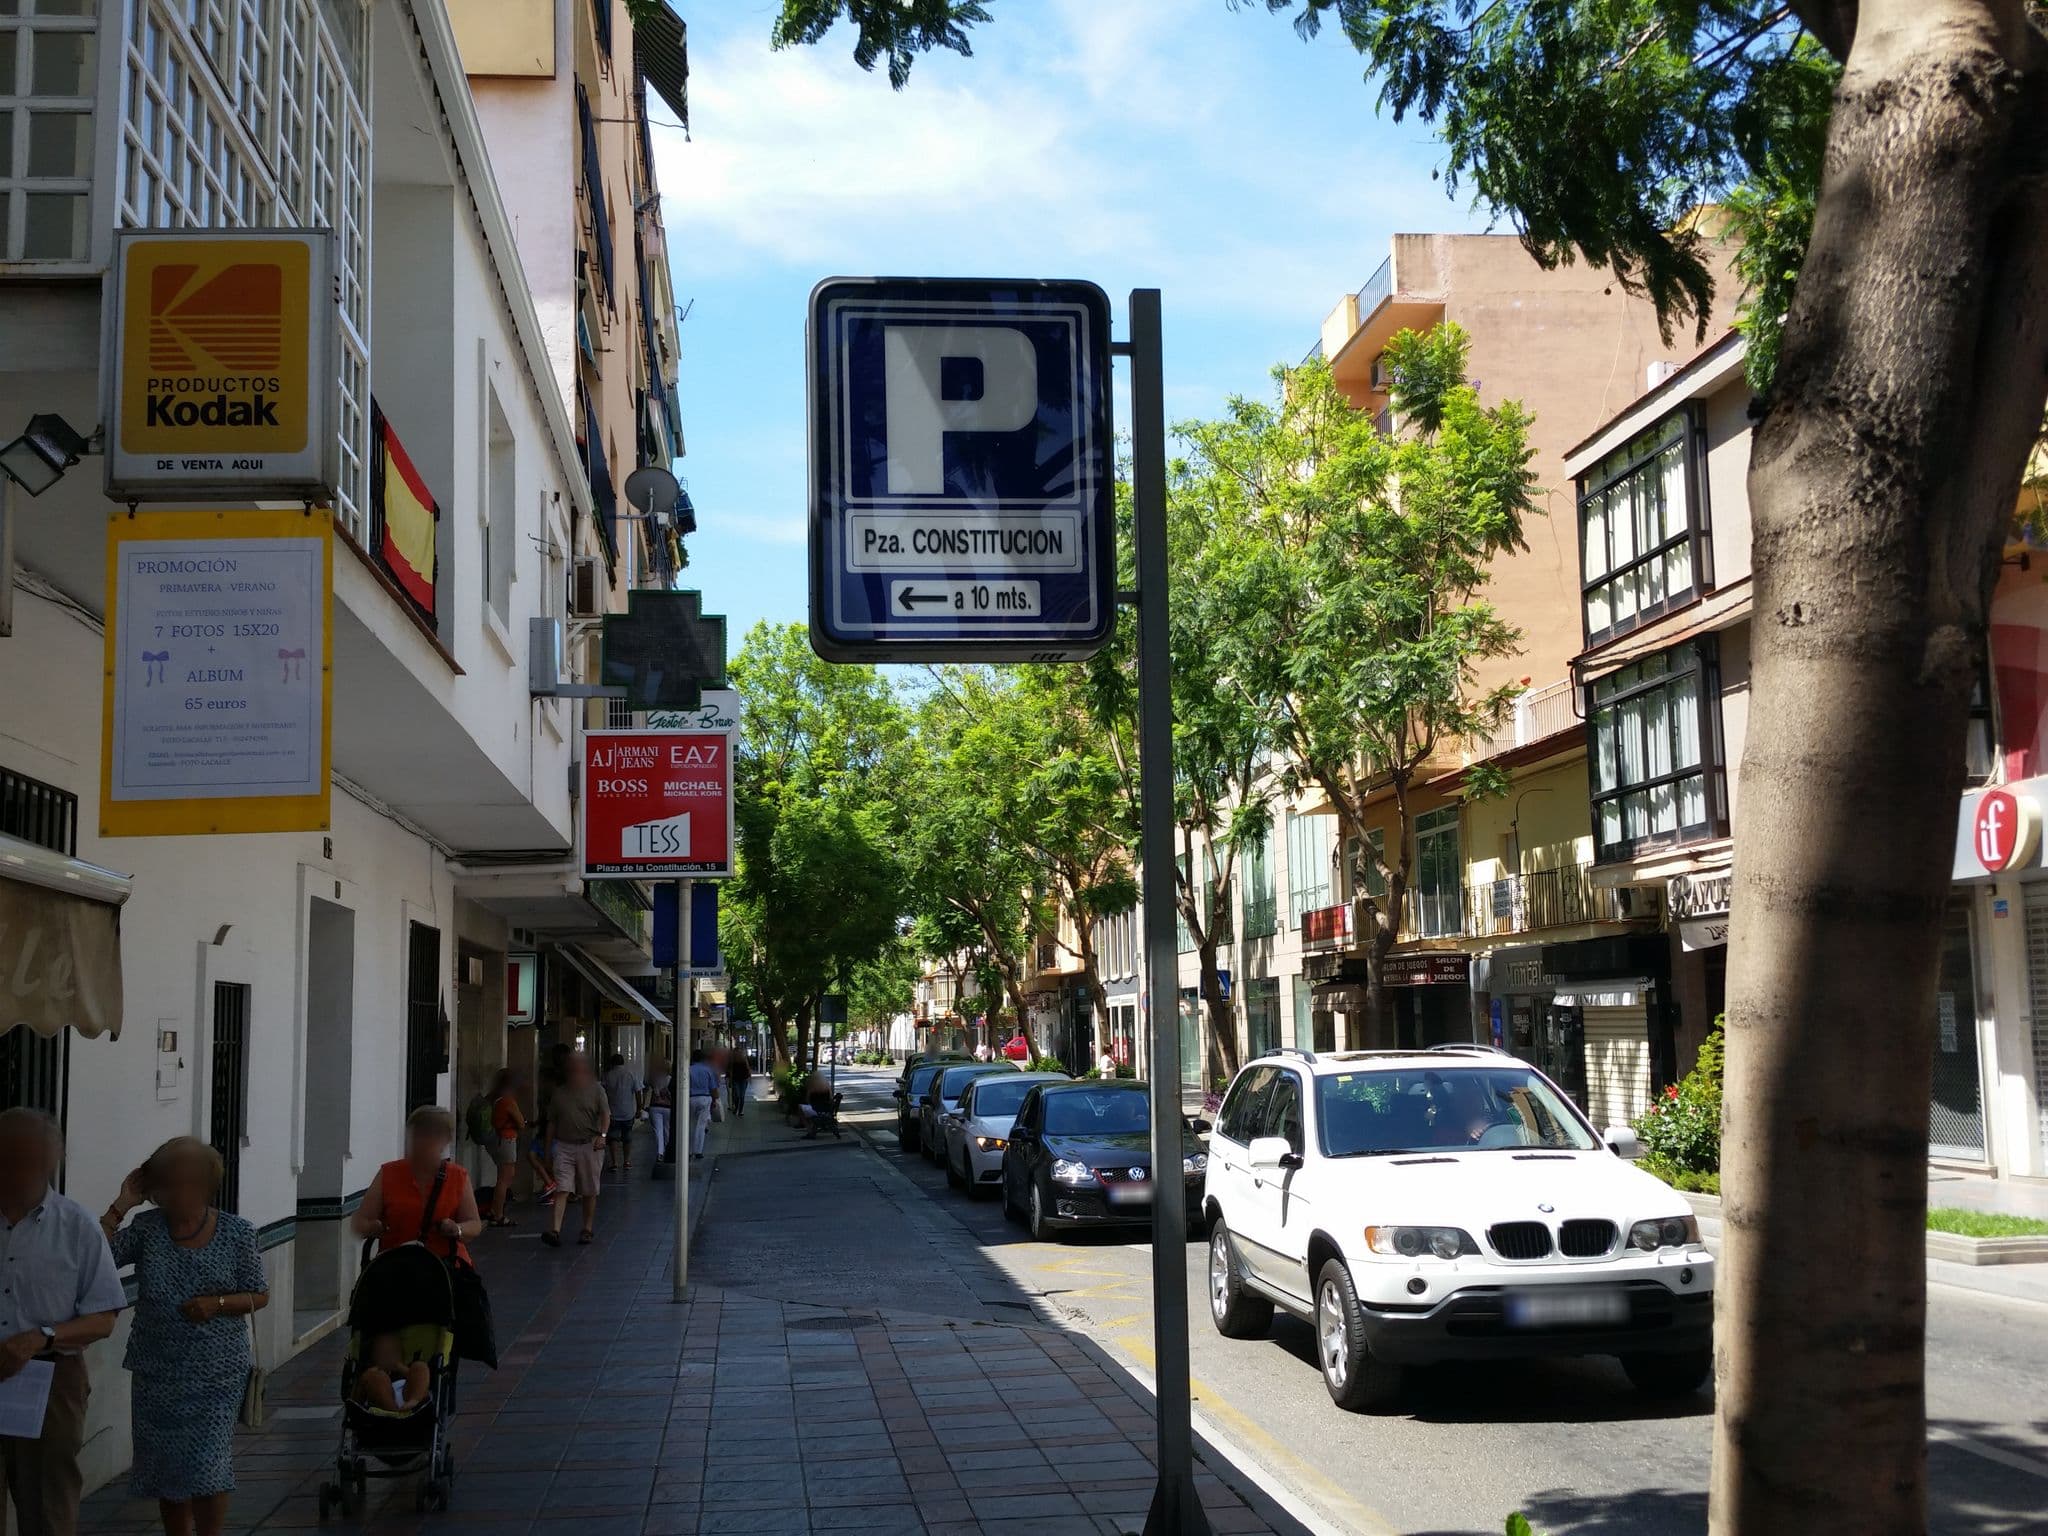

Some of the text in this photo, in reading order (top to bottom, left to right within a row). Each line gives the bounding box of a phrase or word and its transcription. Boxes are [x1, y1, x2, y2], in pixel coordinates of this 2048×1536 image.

[147, 377, 280, 393] PRODUCTOS
[146, 394, 280, 427] Kodak
[884, 325, 1038, 494] P
[157, 459, 263, 470] DE VENTA AQUI
[864, 529, 1063, 555] Pza. CONSTITUCION
[137, 557, 238, 574] PROMOCIÓN
[159, 584, 222, 593] PRIMAVERA
[955, 586, 1032, 611] a 10 mts.
[155, 624, 280, 638] 7 FOTOS 15X20
[187, 669, 244, 683] ALBUM
[185, 698, 247, 710] 65 euros
[697, 704, 736, 729] Bravo
[617, 746, 660, 757] ARMANI
[671, 745, 719, 764] EA7
[620, 757, 655, 769] JEANS
[597, 779, 648, 793] BOSS
[664, 781, 722, 791] MICHAEL
[633, 824, 680, 853] TESS
[596, 863, 716, 872] Plaza de la Constitución, 15
[1435, 957, 1463, 965] SALON
[1434, 973, 1466, 981] JUEGOS
